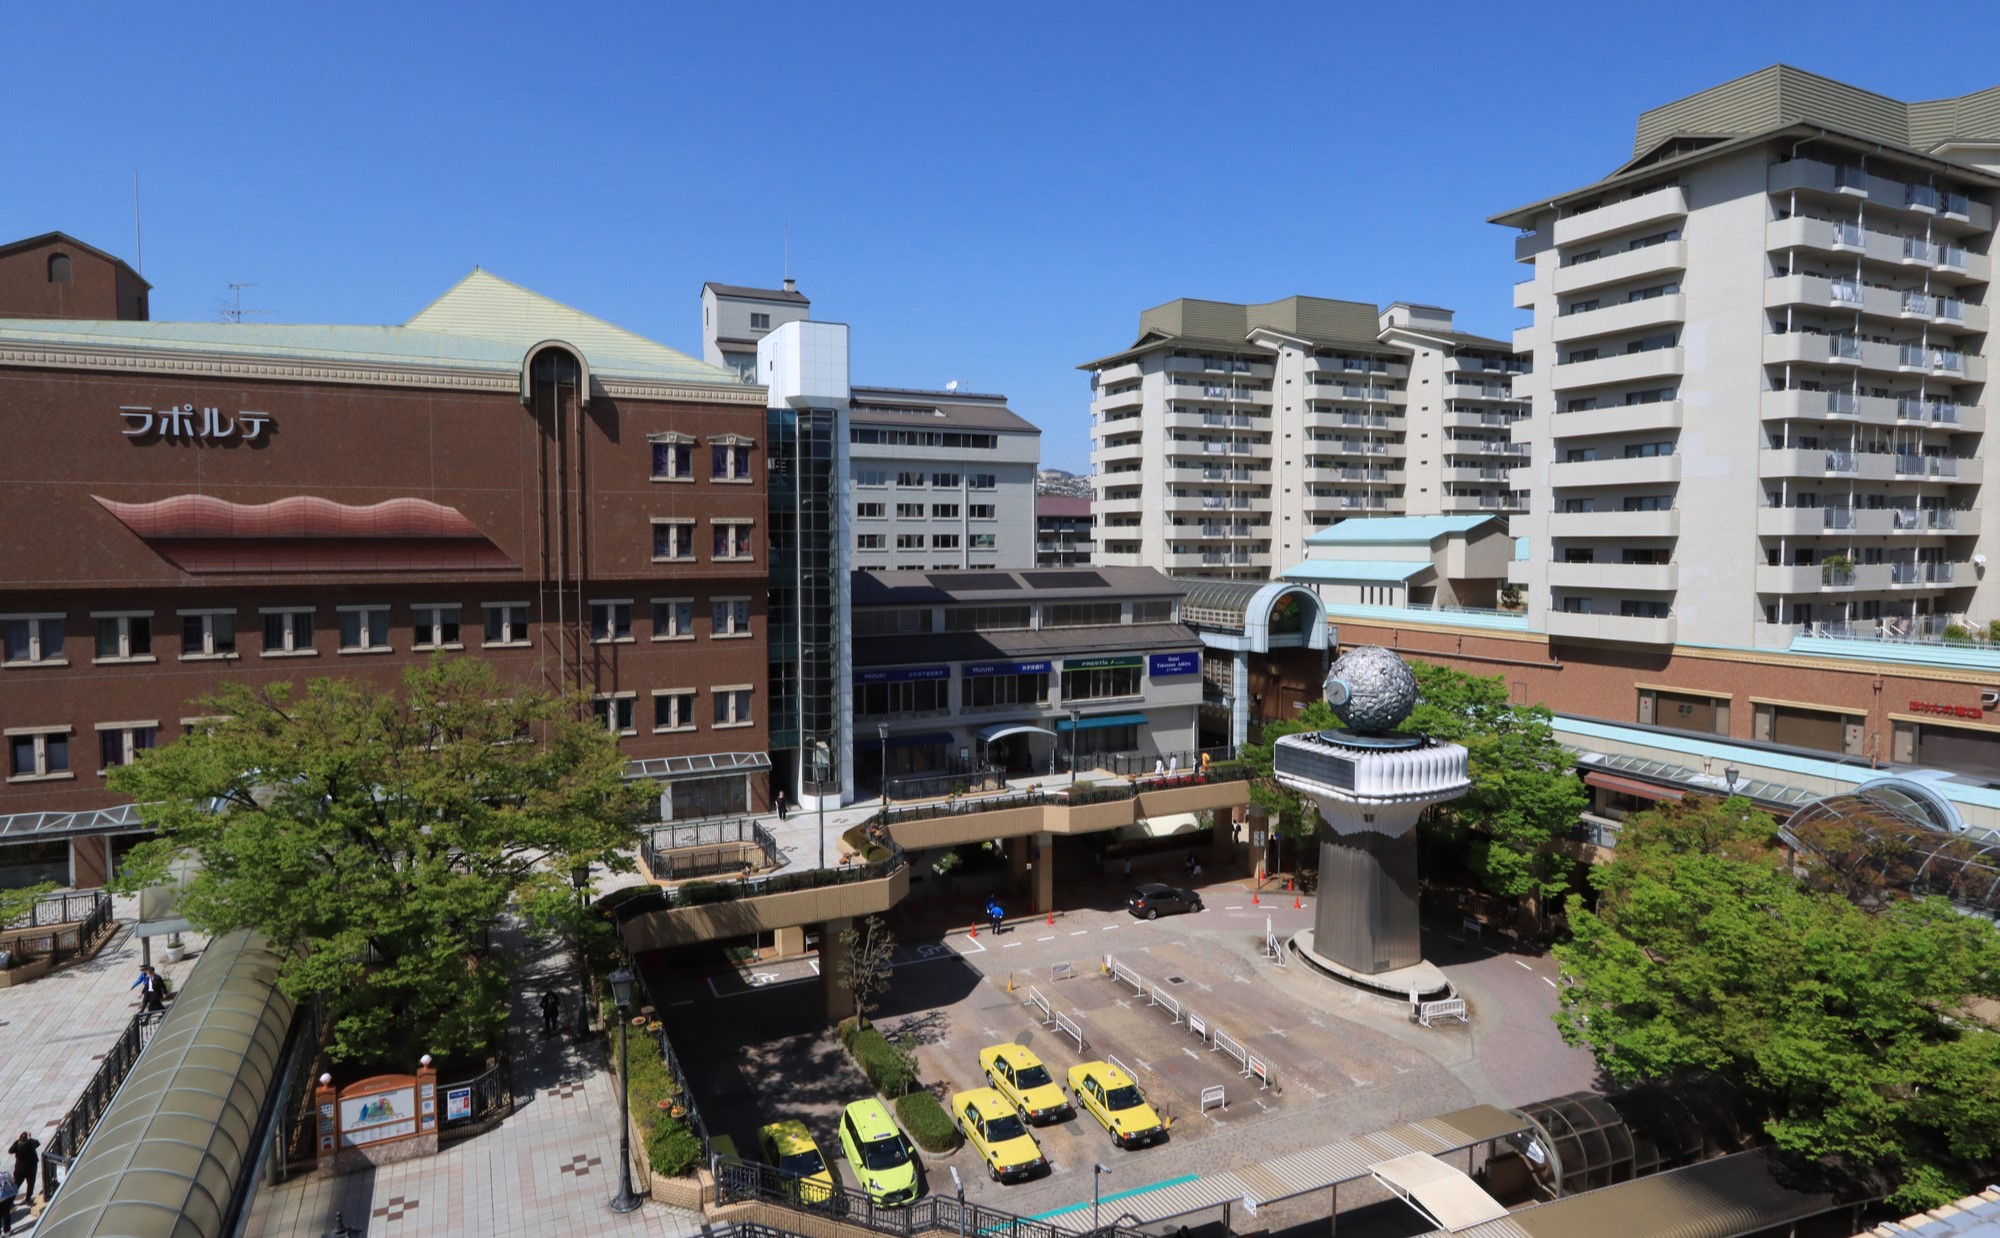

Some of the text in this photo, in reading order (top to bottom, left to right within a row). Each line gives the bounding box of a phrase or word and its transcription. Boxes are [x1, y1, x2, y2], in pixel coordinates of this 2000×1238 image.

[119, 403, 270, 439] ラポルテ
[863, 671, 887, 680] MIZUHO
